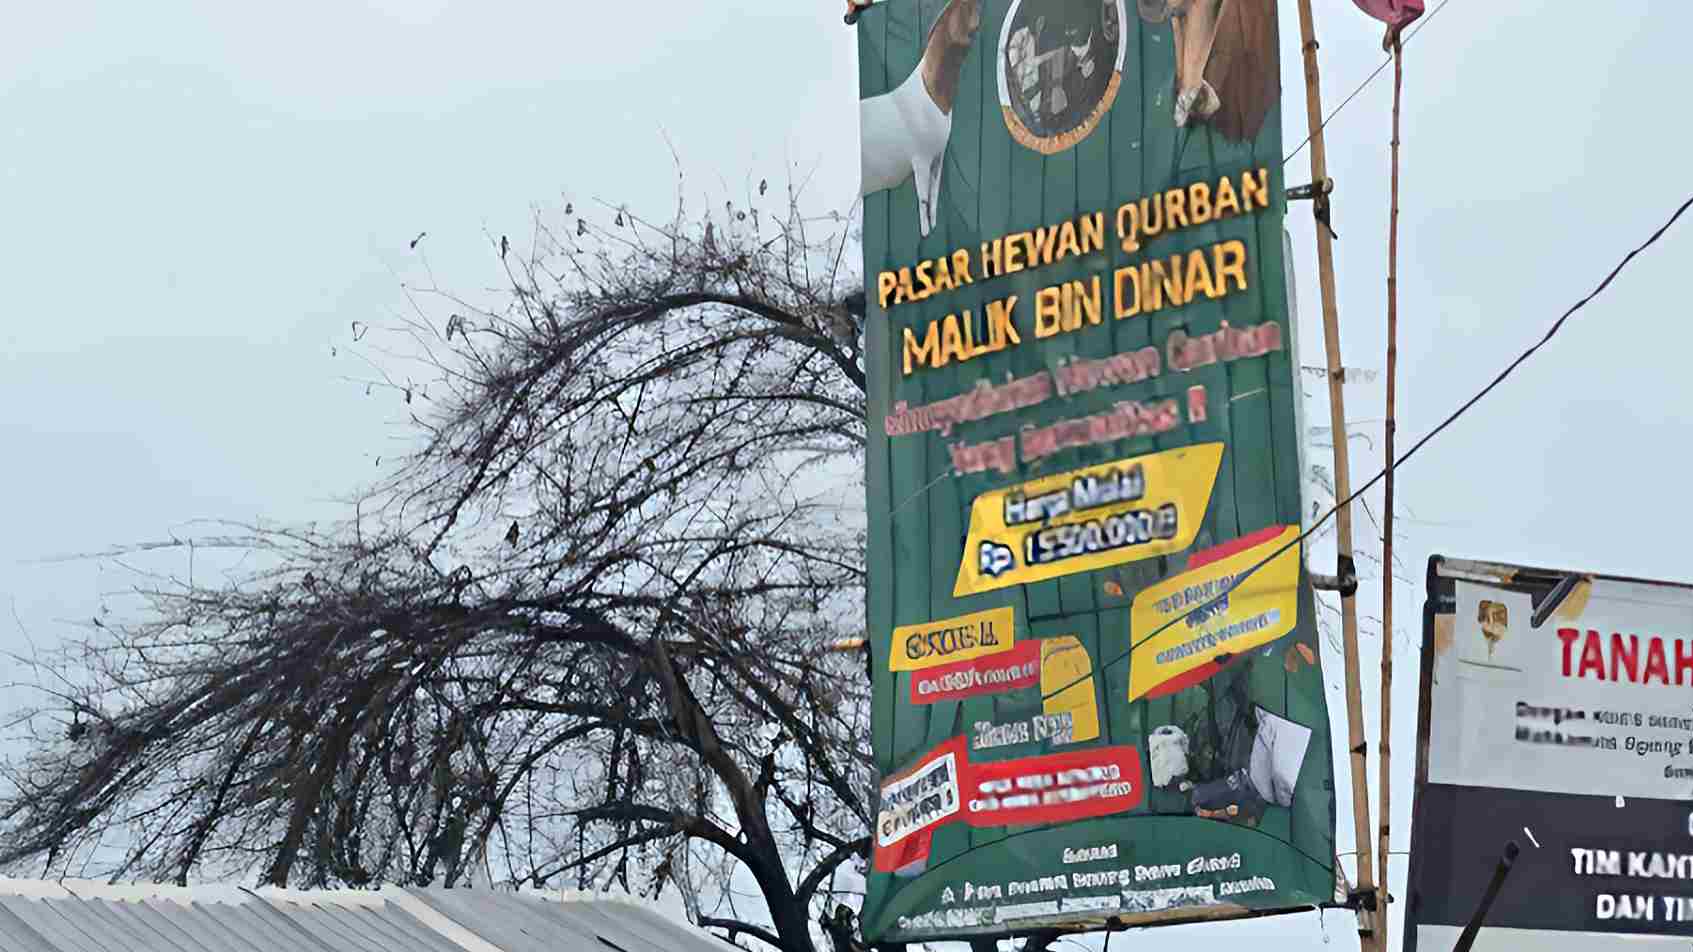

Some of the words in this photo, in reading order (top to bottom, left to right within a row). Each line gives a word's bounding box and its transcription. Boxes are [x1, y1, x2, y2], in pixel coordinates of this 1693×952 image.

[878, 248, 973, 308] PASAR
[982, 212, 1104, 279] HEWAN
[1117, 168, 1270, 253] QURBAN
[903, 295, 1021, 376] MALIK
[1035, 276, 1102, 340] BIN
[1114, 240, 1248, 320] DINAR
[1571, 848, 1620, 876] TIM
[1596, 894, 1654, 921] DAN
